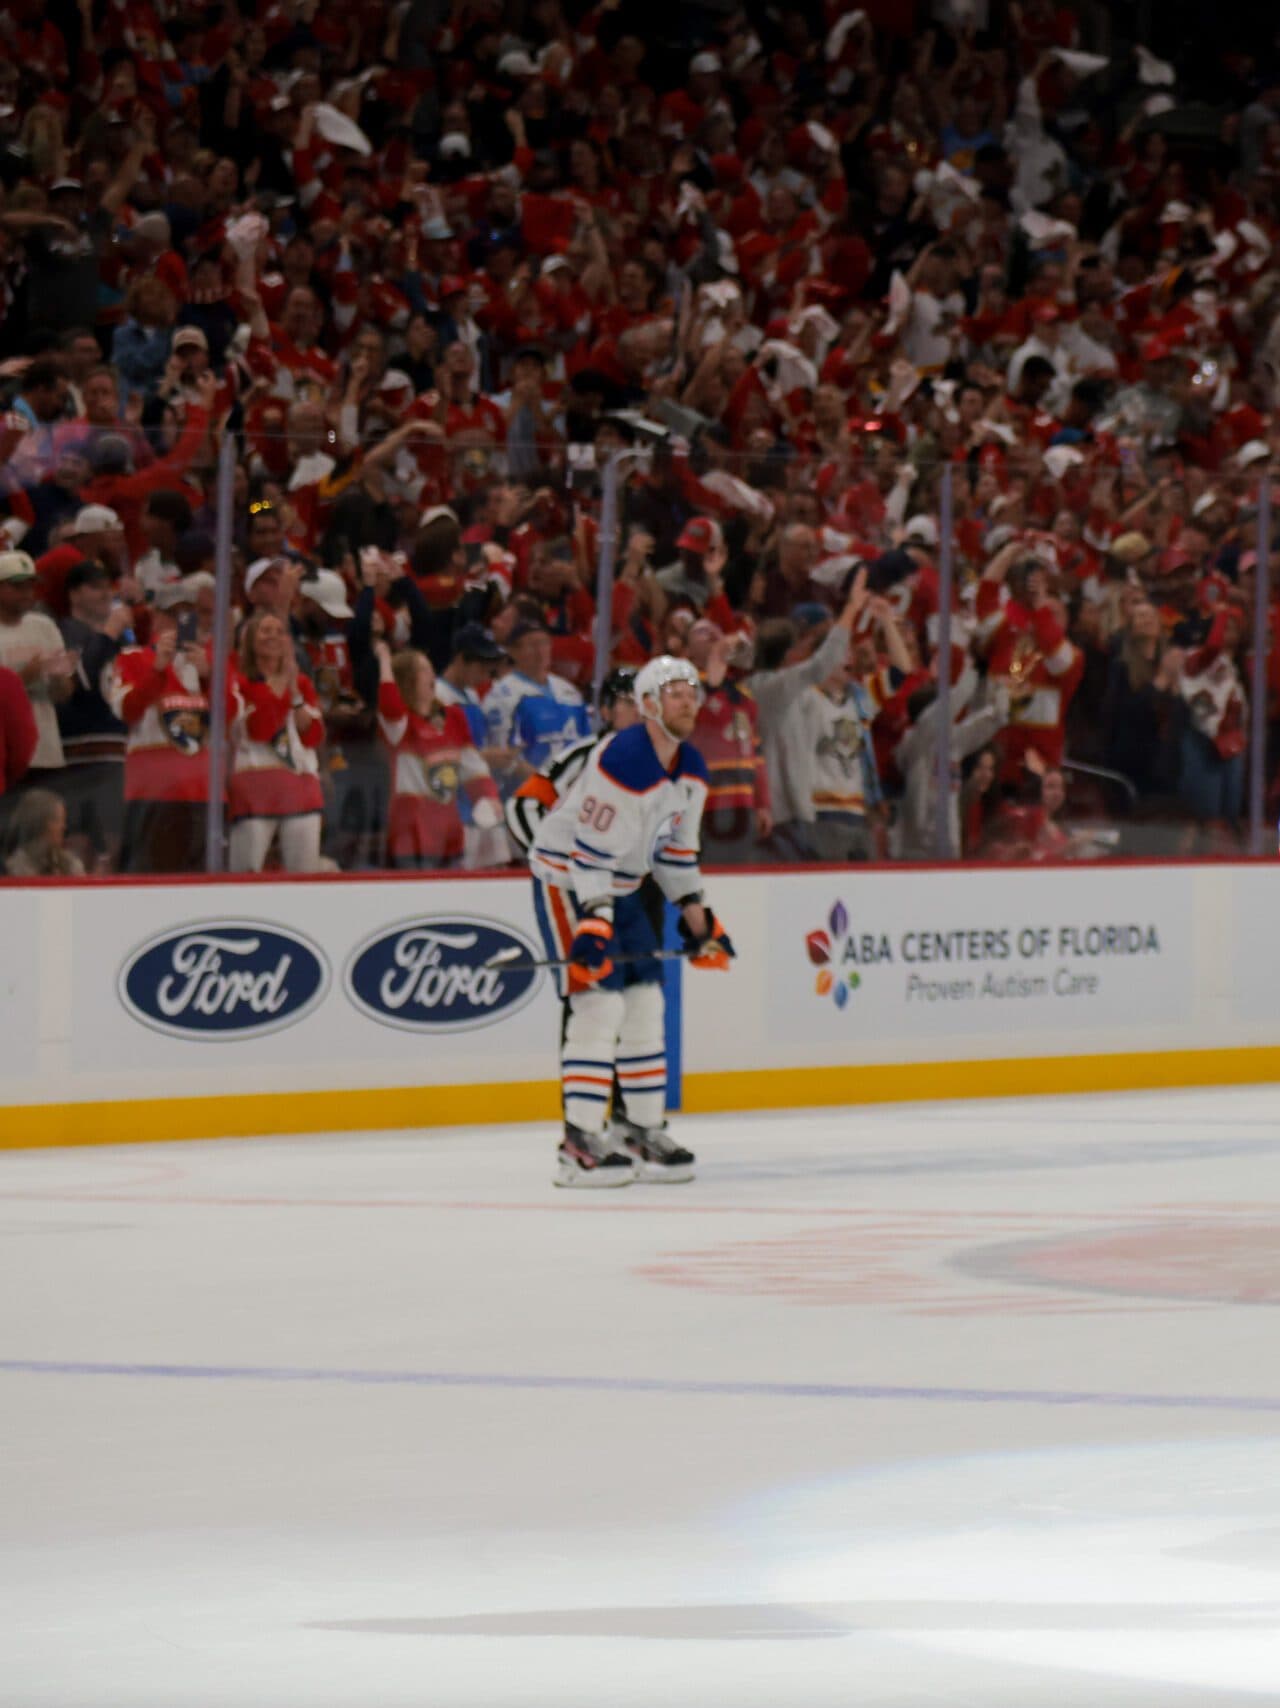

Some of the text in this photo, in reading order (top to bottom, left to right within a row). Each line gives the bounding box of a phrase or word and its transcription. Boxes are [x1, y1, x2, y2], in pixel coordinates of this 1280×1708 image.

[579, 796, 616, 833] 90
[842, 924, 1160, 964] ABA CENTERS OF FLORIDA
[157, 934, 291, 1016] Ford
[906, 968, 1097, 1001] Proven Autism Care
